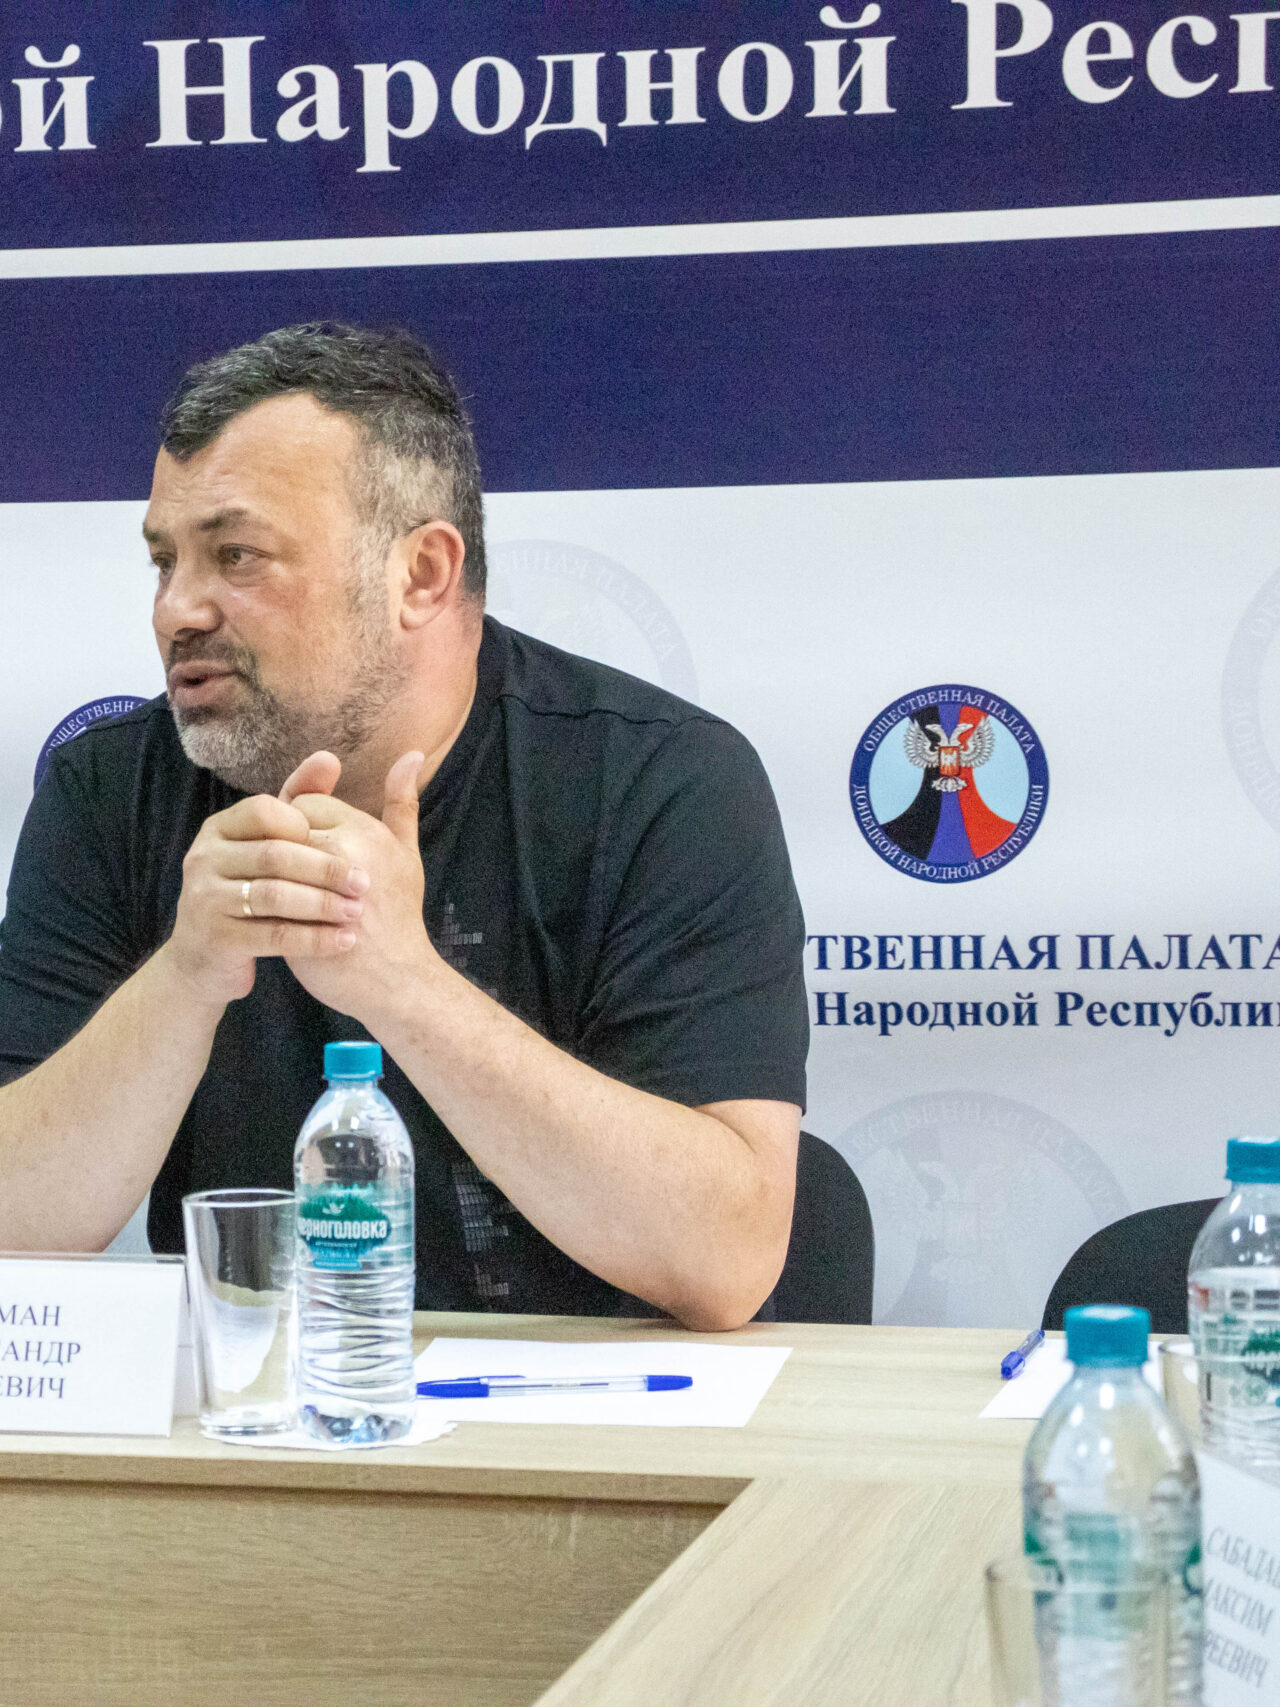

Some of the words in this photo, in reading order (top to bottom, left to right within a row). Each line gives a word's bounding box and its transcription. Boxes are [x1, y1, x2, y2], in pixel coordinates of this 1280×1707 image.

[143, 3, 897, 173] Народной
[863, 689, 985, 753] ОБЩЕСТВЕННАЯ
[986, 698, 1036, 755] ПАЛАТА
[853, 783, 900, 861] ДОНЕЦКОЙ
[897, 852, 982, 880] НАРОДНОЙ
[982, 784, 1044, 872] РЕСПУБЛИКИ
[807, 935, 1060, 970] ТВЕННАЯ
[813, 992, 1039, 1037] Народной
[1055, 991, 1280, 1037] Республи
